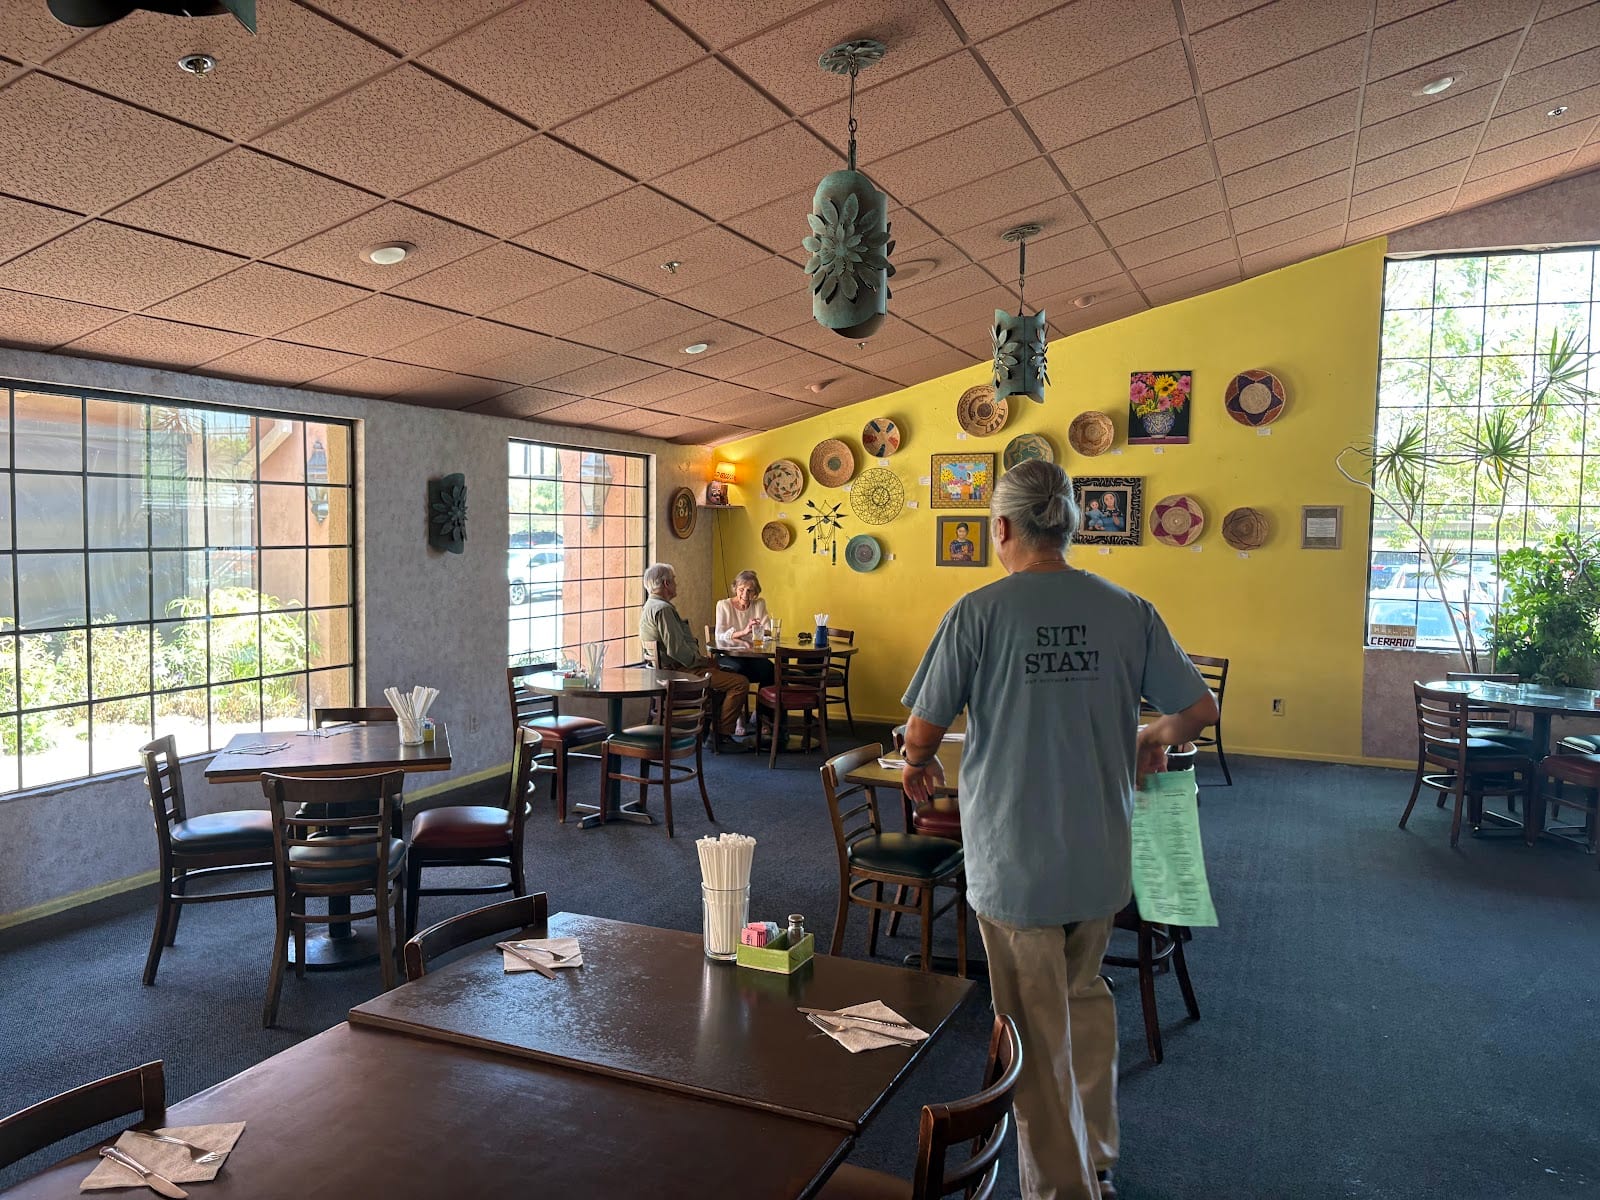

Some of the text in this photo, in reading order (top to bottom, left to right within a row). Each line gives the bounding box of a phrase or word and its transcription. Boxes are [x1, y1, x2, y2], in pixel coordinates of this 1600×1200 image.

[1036, 625, 1087, 647] SIT!
[1370, 637, 1415, 648] CERRADO
[1025, 650, 1100, 674] STAY!
